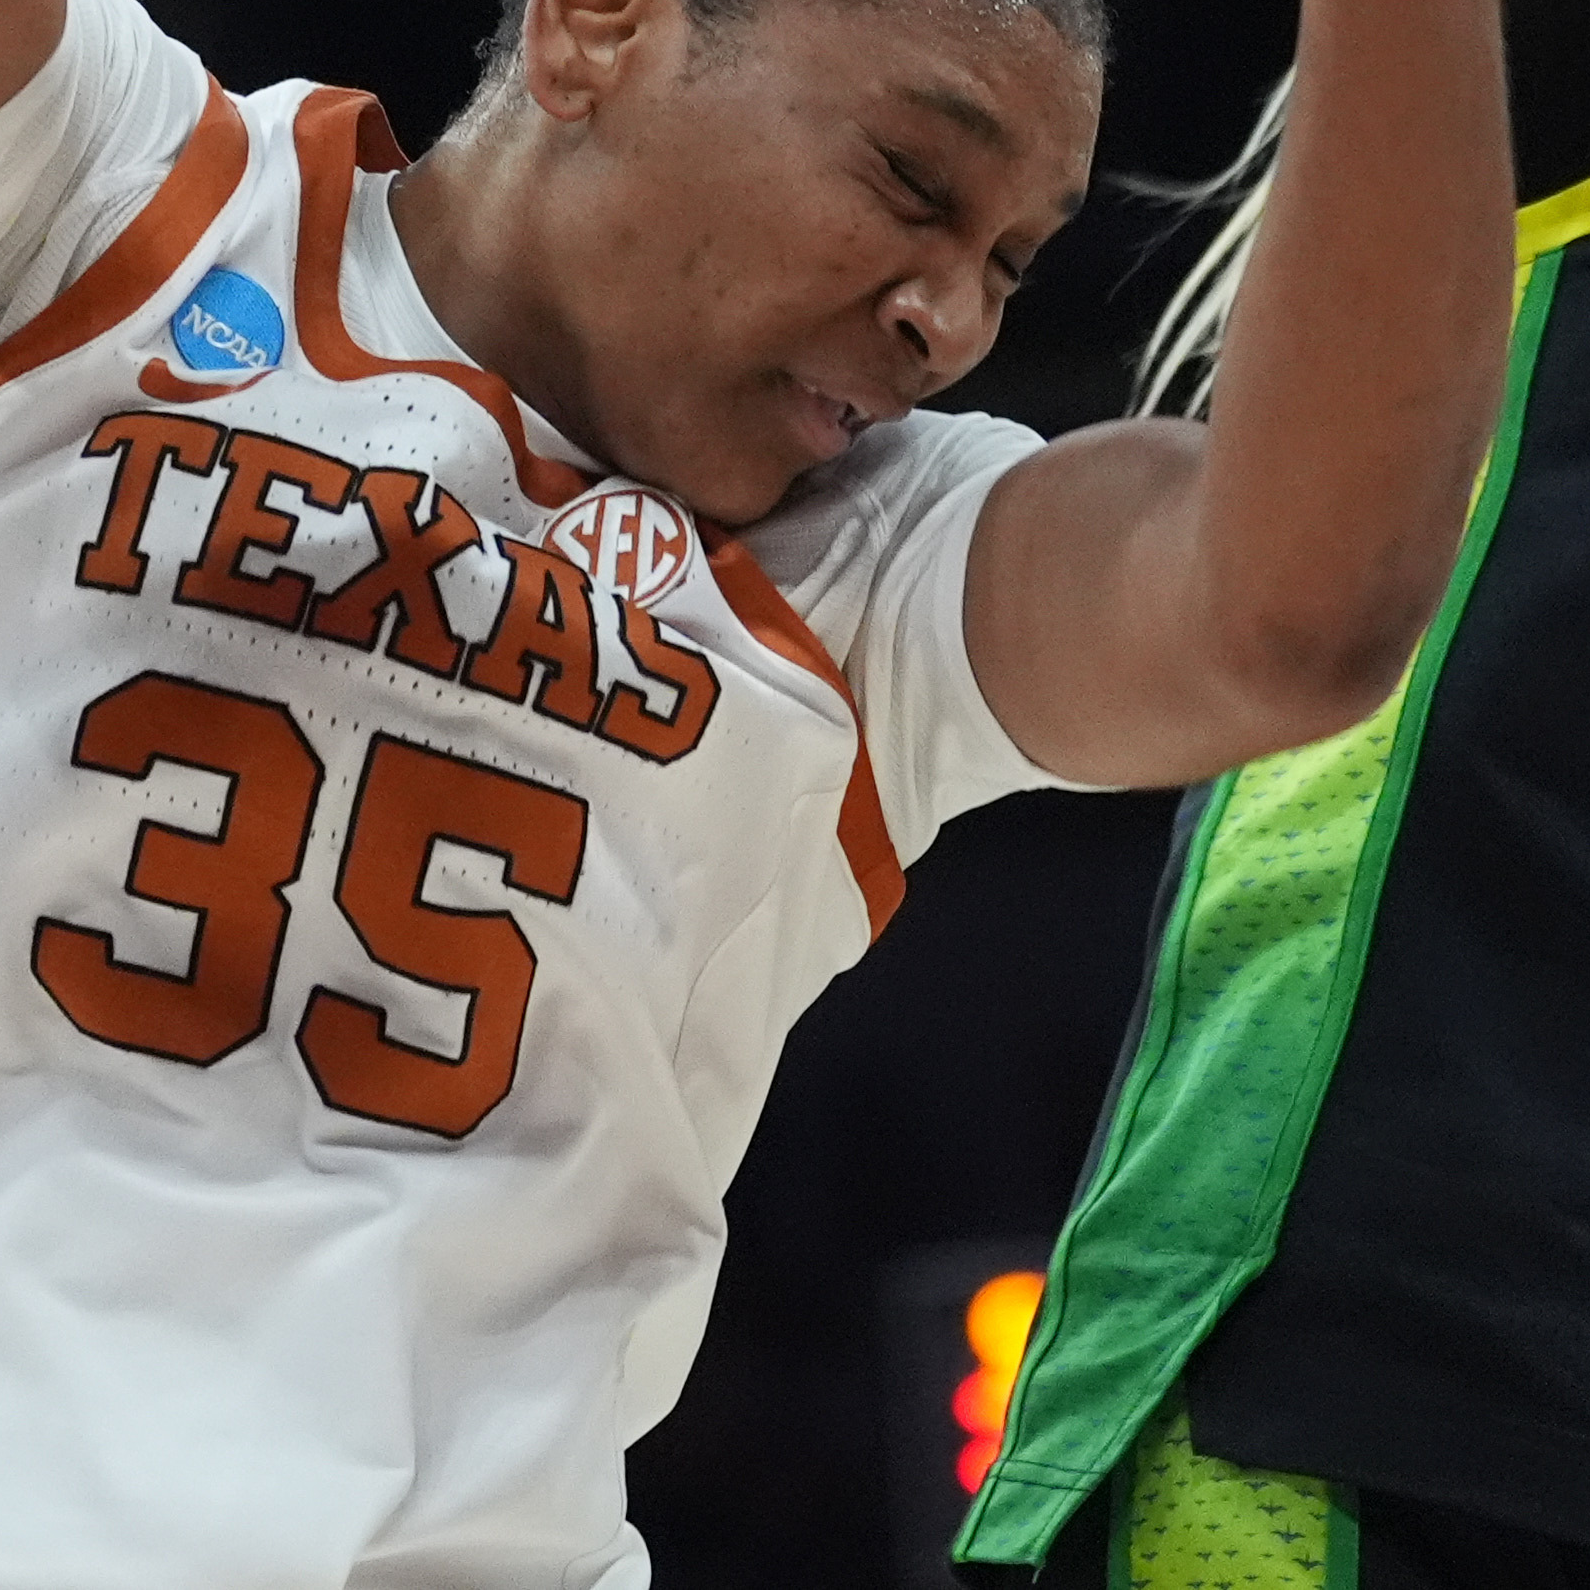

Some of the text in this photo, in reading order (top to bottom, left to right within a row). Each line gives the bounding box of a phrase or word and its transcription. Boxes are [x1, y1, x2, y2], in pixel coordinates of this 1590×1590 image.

[180, 303, 268, 368] NCAA
[74, 410, 721, 766] TEXAS
[551, 493, 679, 602] SEC
[29, 669, 591, 1140] 35
